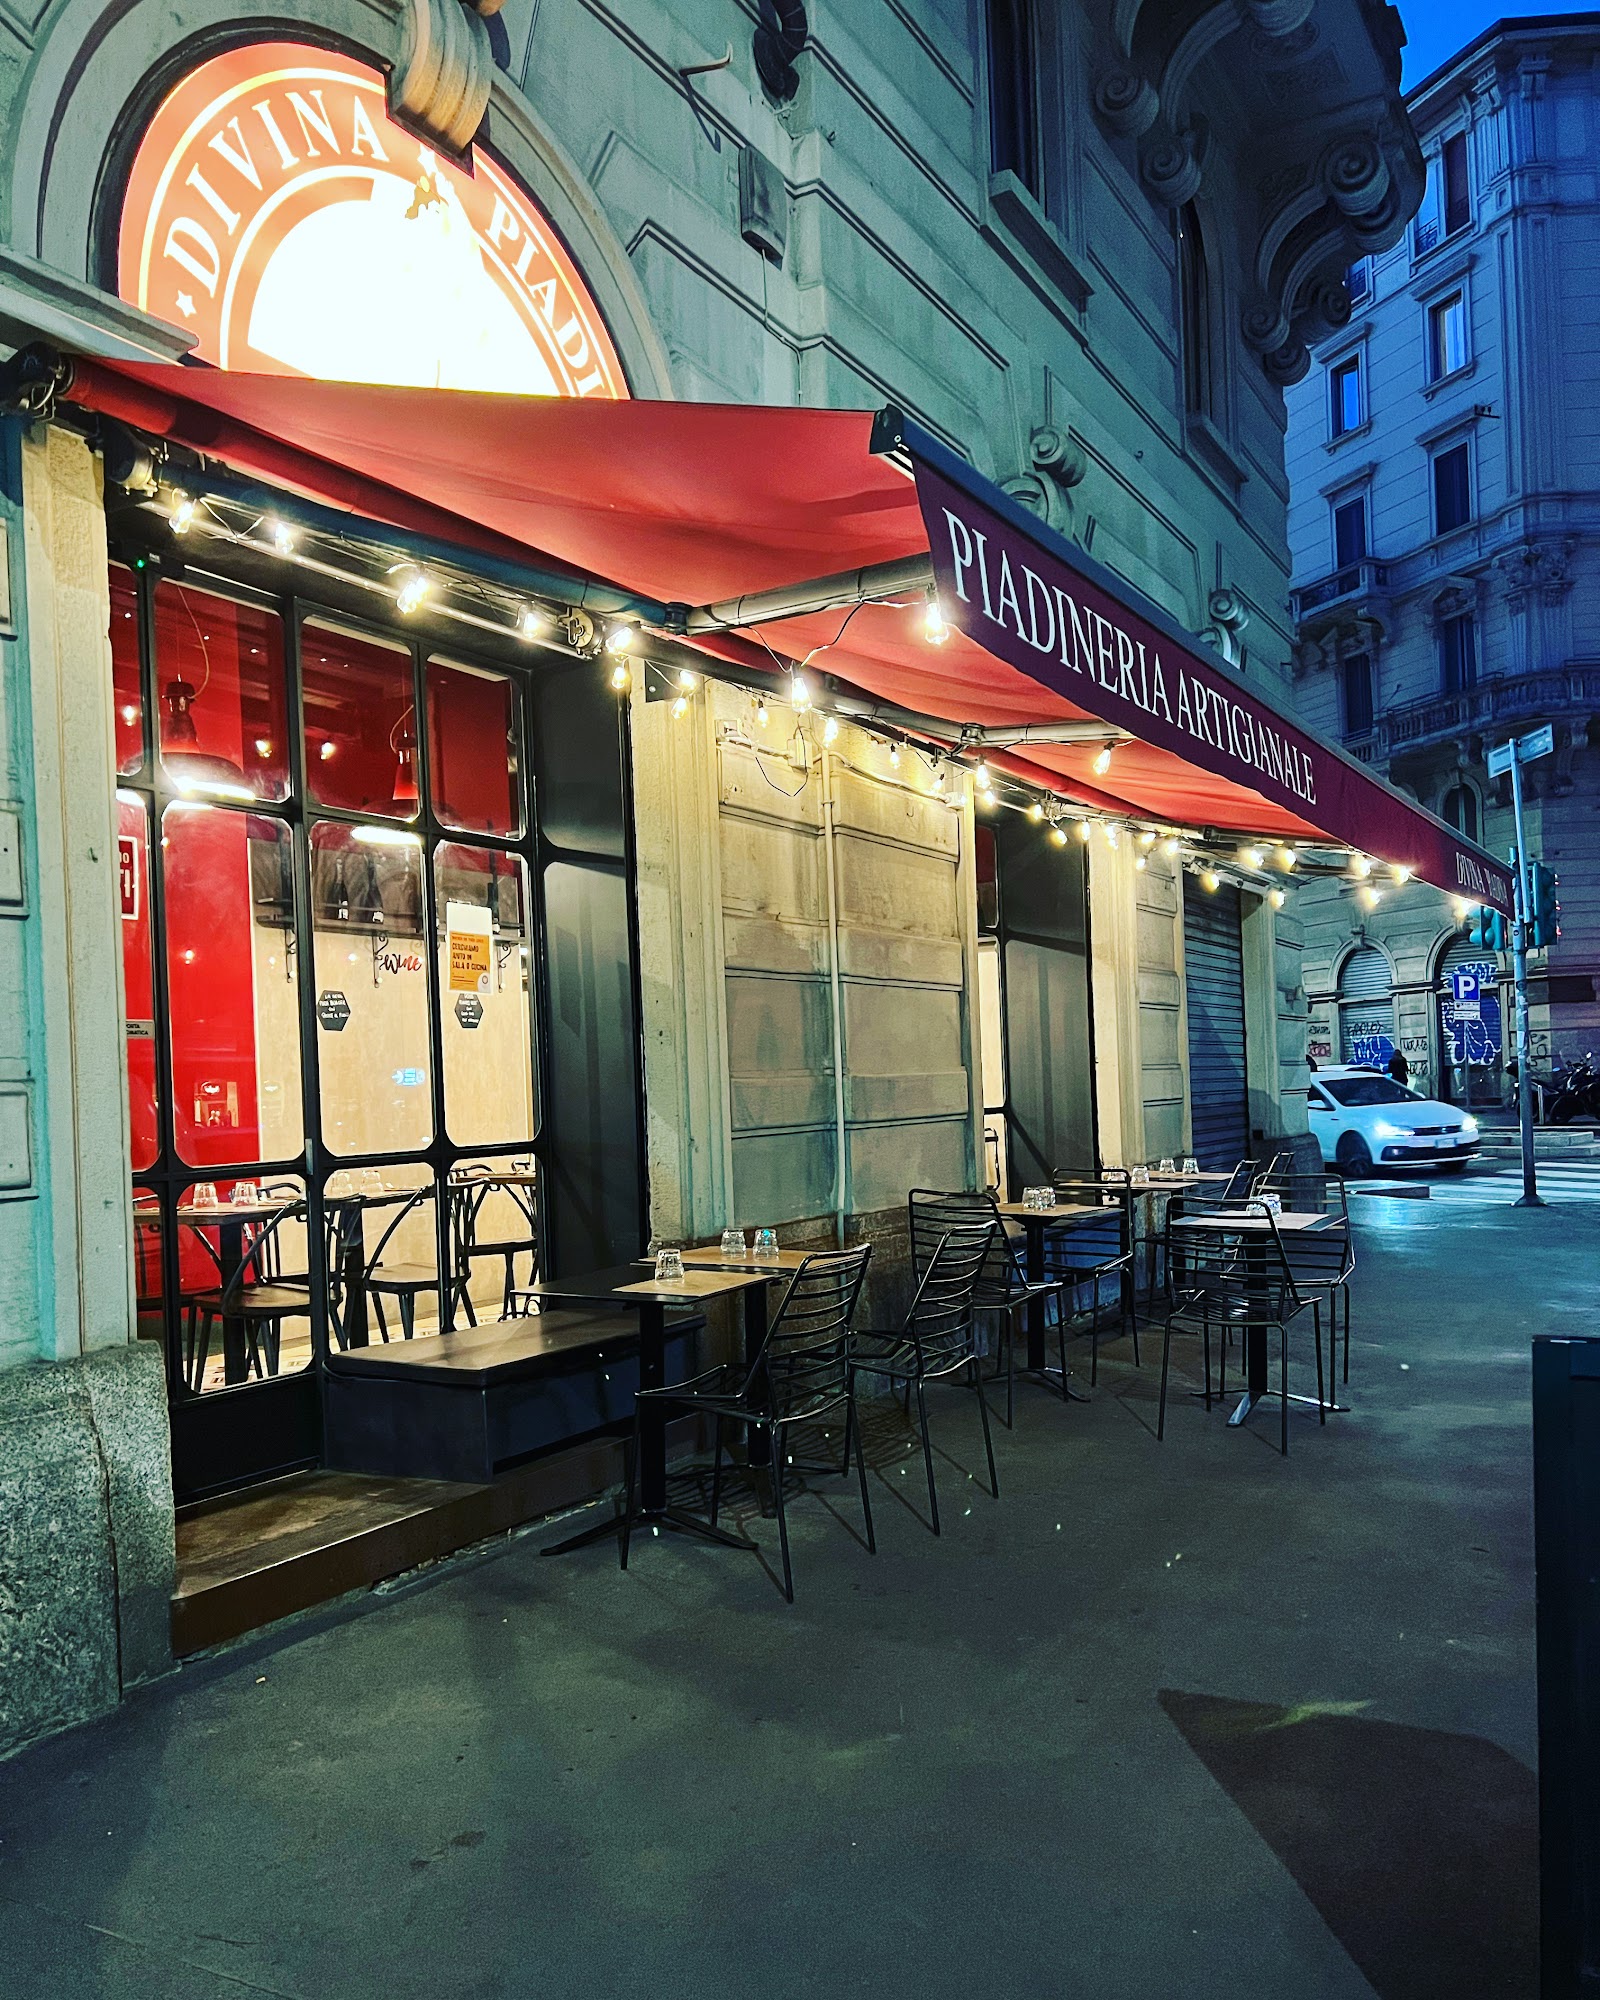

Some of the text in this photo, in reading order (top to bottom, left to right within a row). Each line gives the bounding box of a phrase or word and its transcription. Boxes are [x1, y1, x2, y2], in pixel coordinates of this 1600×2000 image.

[164, 89, 606, 398] DIVINA PIADI
[941, 506, 1317, 805] PIADINERIA ARTIGIANALE
[1456, 851, 1486, 893] DIVINA
[1458, 975, 1476, 999] P
